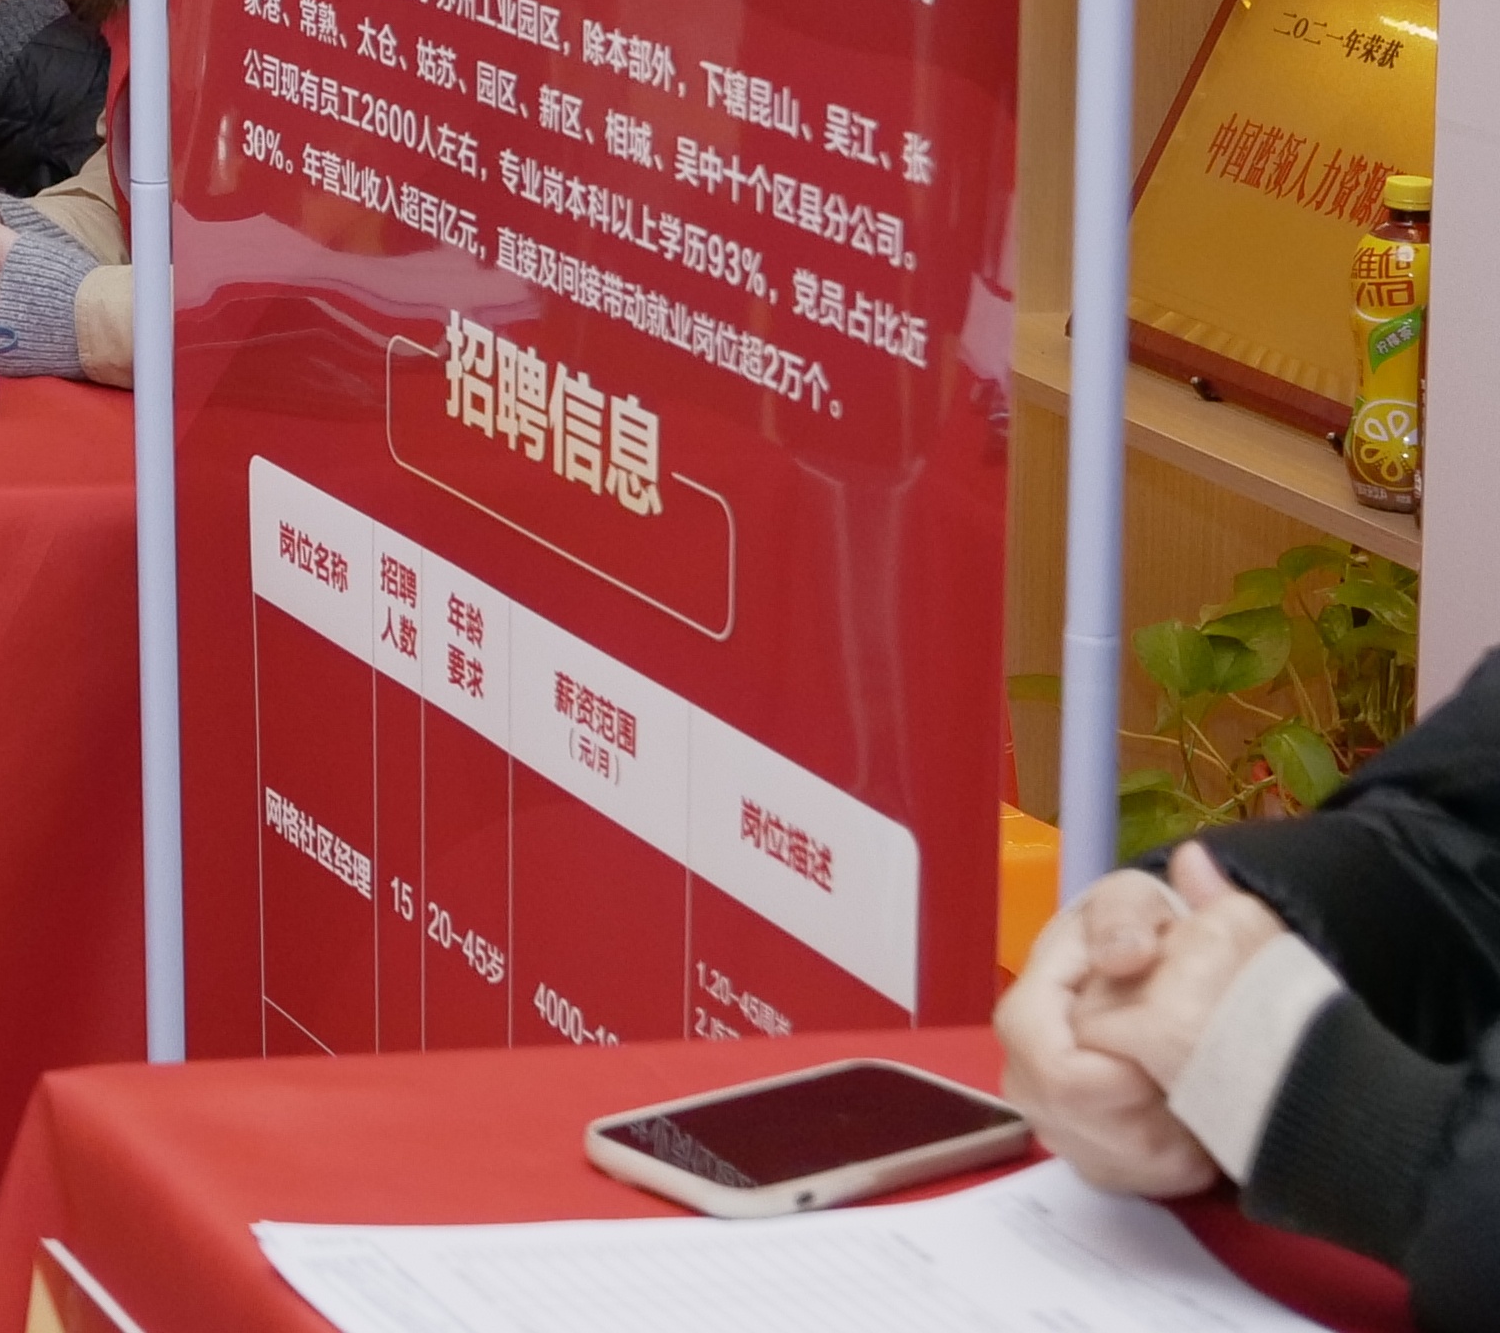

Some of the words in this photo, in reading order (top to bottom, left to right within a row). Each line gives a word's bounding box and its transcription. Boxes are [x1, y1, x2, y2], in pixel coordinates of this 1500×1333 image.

[1205, 112, 1406, 233] 中国蓝领人力资源
[445, 308, 663, 517] 招聘信息
[277, 520, 349, 594] 岗位名称
[379, 552, 419, 609] 招聘
[380, 606, 419, 661] 人数
[446, 591, 485, 650] 年龄
[446, 643, 485, 700] 要求
[553, 669, 639, 758] 薪资范围
[265, 786, 373, 901] 网格社区经理
[739, 794, 835, 894] 岗位描述
[390, 875, 414, 921] 15
[427, 901, 505, 984] 20-45岁
